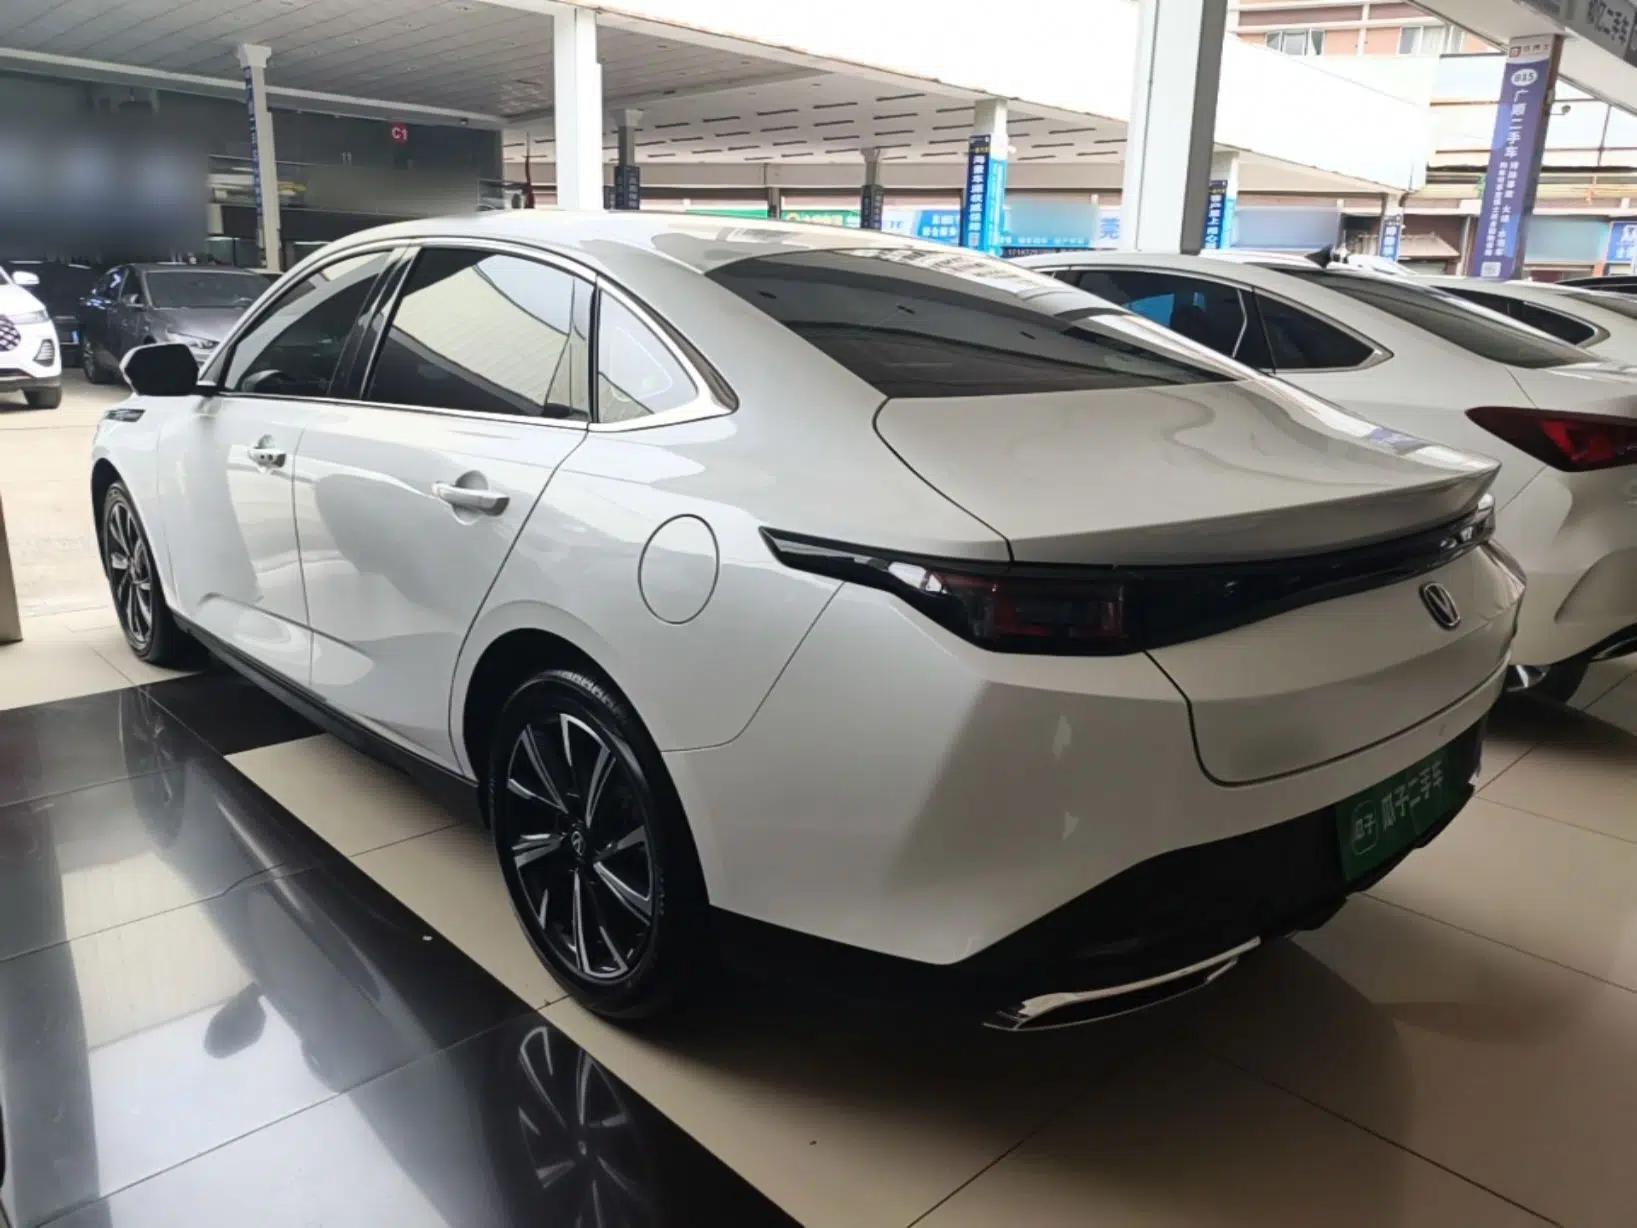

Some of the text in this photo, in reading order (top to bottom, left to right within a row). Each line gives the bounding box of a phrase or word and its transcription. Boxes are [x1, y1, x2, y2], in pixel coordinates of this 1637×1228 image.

[392, 126, 408, 140] C1
[1381, 760, 1444, 832] 瓜子二手车
